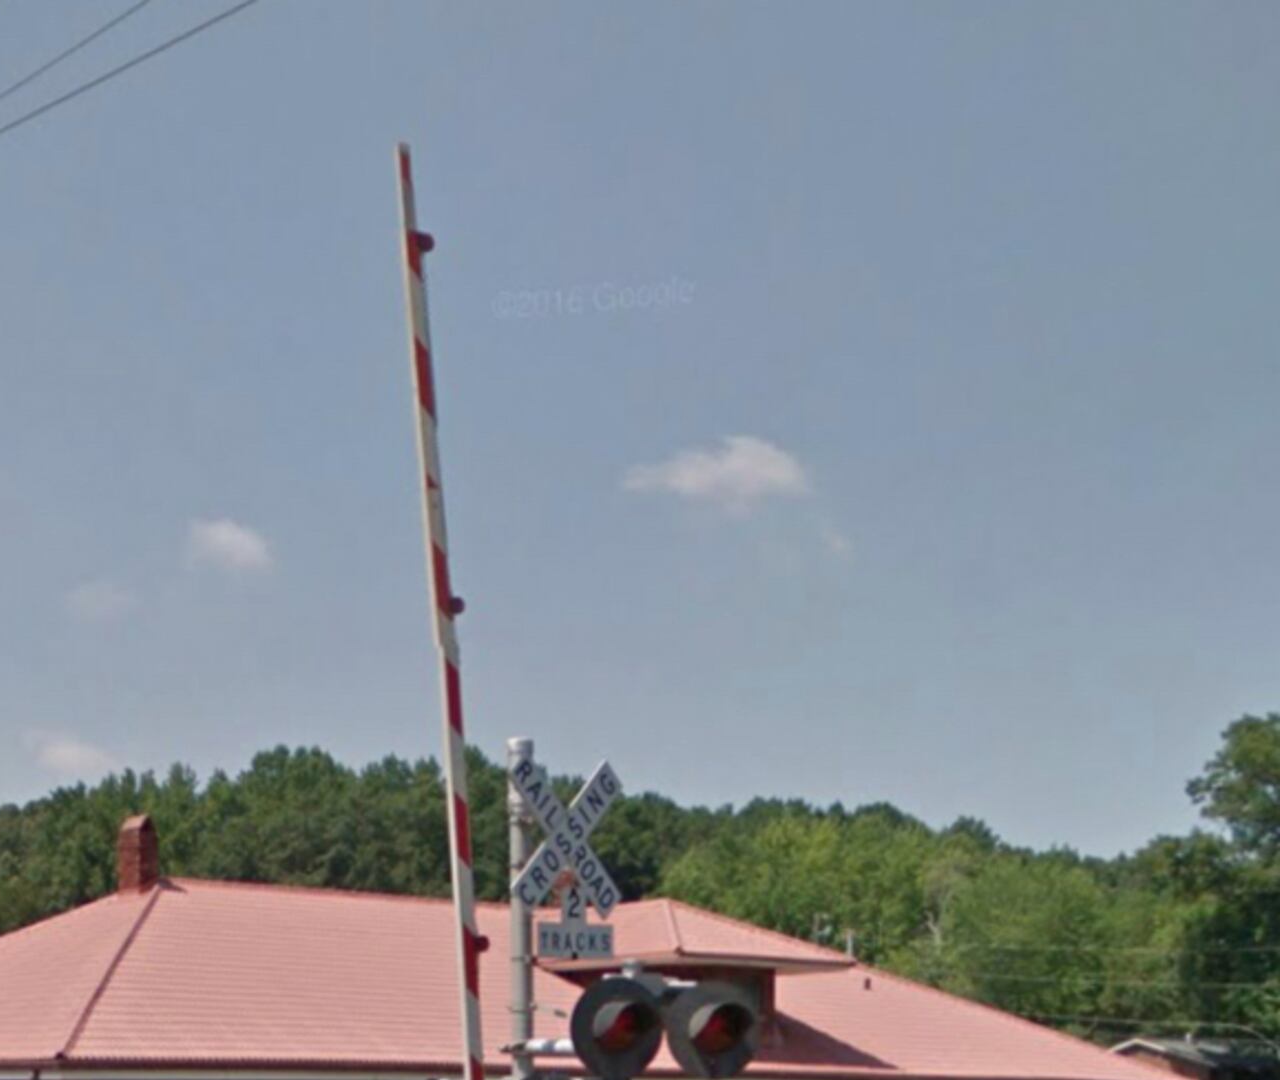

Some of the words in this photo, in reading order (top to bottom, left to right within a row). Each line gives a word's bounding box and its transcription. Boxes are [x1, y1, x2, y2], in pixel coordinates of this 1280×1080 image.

[518, 773, 616, 907] CROSSING
[567, 893, 581, 918] 2
[541, 929, 612, 953] TRACKS
